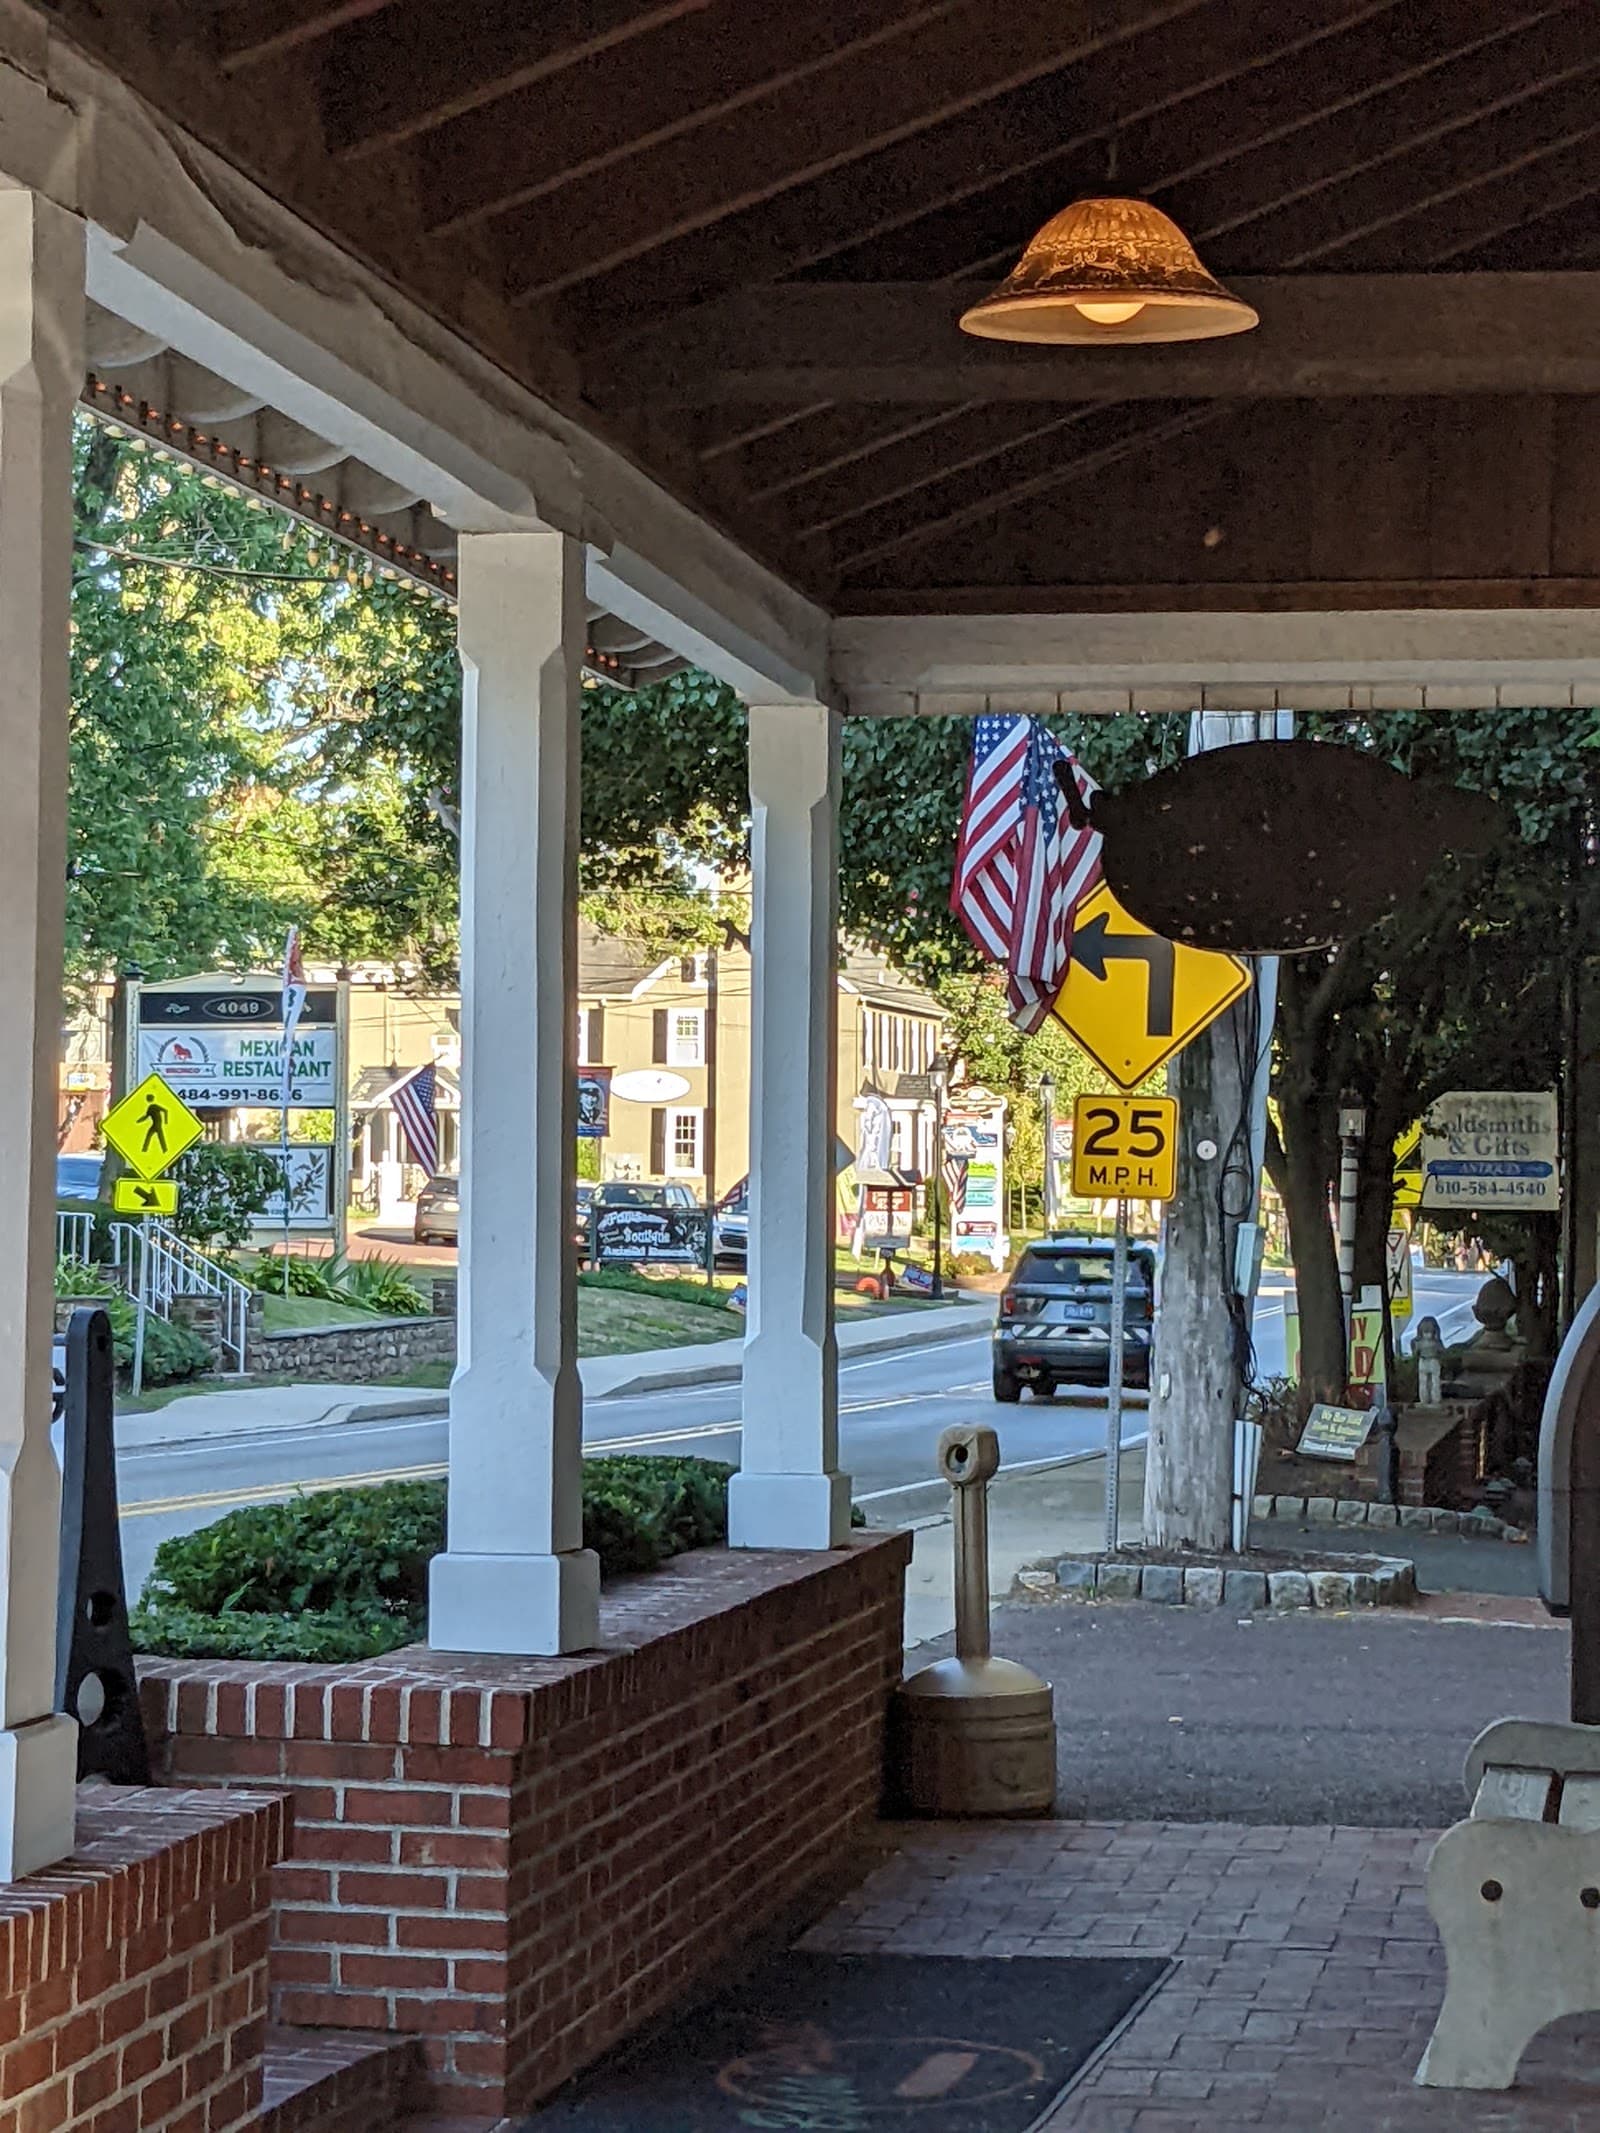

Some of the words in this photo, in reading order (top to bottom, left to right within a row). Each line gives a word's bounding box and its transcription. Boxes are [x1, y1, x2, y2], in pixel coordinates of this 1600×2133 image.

[177, 1088, 302, 1101] 484-991-866
[1083, 1107, 1165, 1158] 25
[1428, 1113, 1551, 1135] oldsmiths
[1448, 1137, 1466, 1155] &
[1474, 1135, 1530, 1156] Gifts
[1435, 1181, 1546, 1197] 610-584-4540
